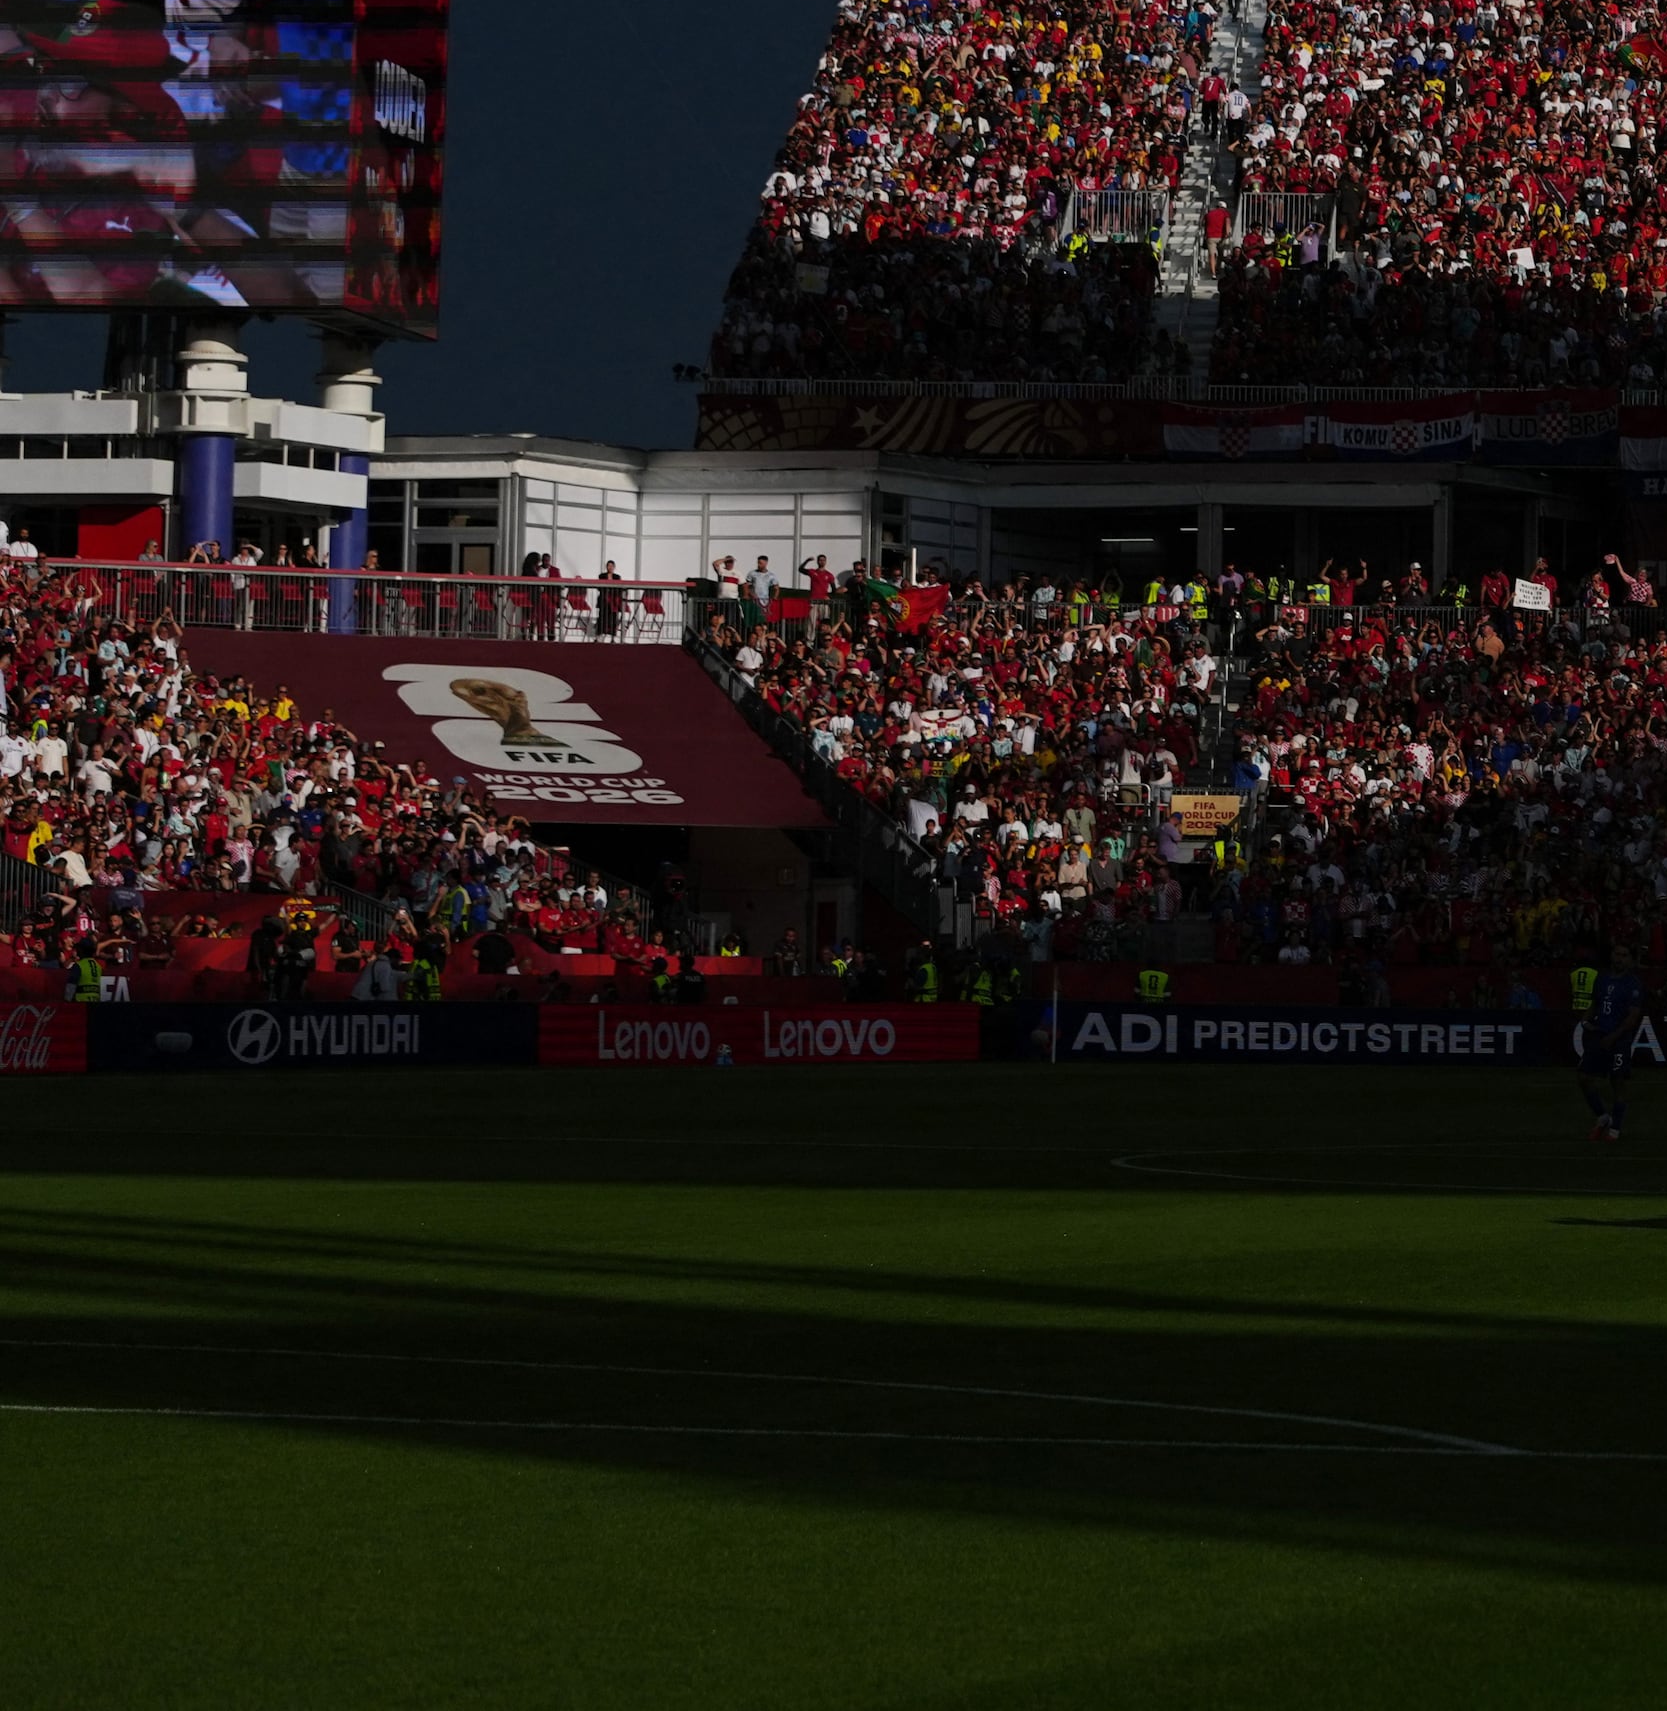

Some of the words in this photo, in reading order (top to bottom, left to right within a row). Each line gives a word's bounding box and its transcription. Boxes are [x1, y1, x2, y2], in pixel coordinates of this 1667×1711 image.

[505, 751, 594, 765] FIFA
[472, 772, 594, 790] WORLD
[598, 777, 666, 788] CUP
[484, 786, 685, 805] 2026
[1193, 802, 1215, 810] FIFA
[100, 976, 132, 1002] FA
[1603, 1001, 1612, 1015] 13
[290, 1014, 420, 1056] HYUNDAI
[599, 1010, 710, 1060] Lenovo
[764, 1010, 896, 1058] Lenovo
[1071, 1012, 1178, 1053] ADI
[1193, 1020, 1523, 1054] PREDICTSTREET
[1613, 1053, 1624, 1067] 13
